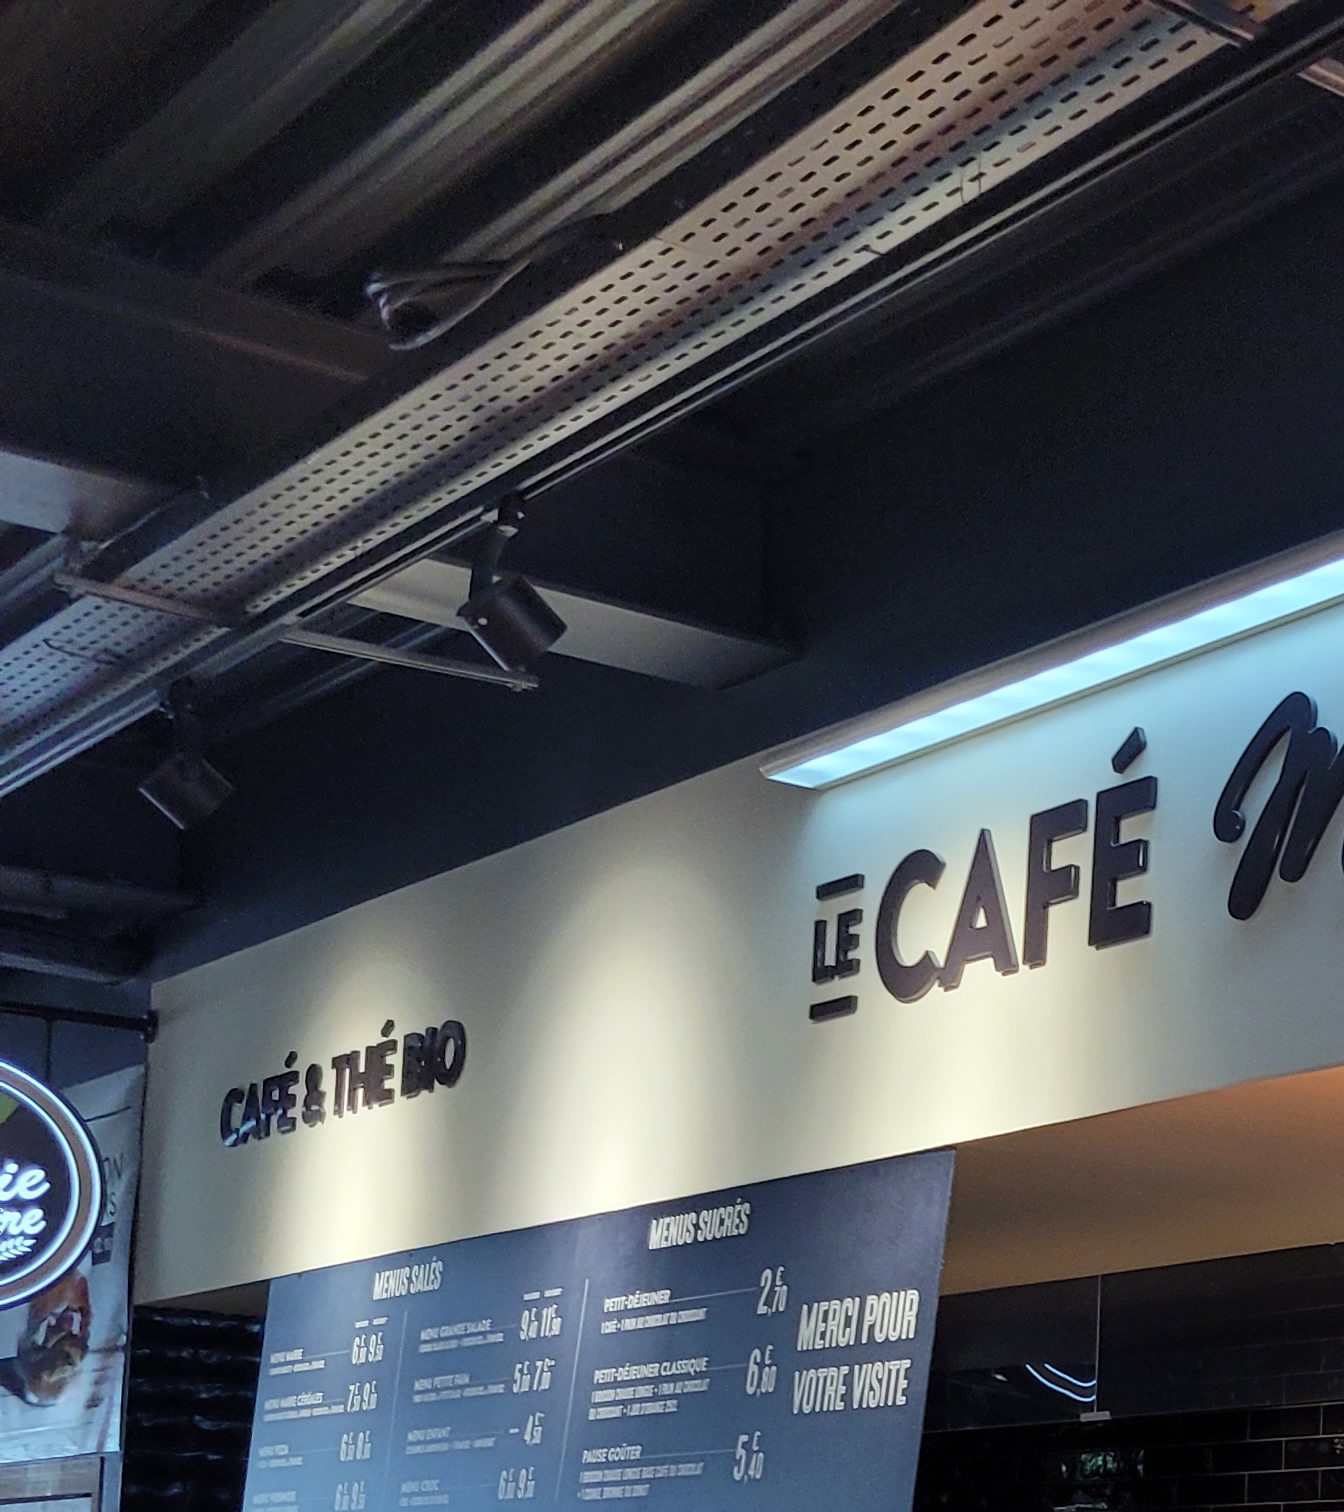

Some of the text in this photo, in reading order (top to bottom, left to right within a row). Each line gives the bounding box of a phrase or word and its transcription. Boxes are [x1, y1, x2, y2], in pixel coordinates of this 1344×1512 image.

[812, 908, 862, 983] LE
[876, 727, 1157, 1004] CAFÉ
[220, 1019, 467, 1147] CAFÉ & THÉ BIO
[648, 1197, 750, 1250] MENUS SUCRÉS
[373, 1256, 443, 1300] MENUS SALÉS
[604, 1289, 671, 1312] PETIT-DÉJEUNER
[797, 1289, 920, 1351] MERCI POUR
[594, 1362, 659, 1384] PETIT-DÉJEUNER
[660, 1357, 709, 1378] CLASSIQUE
[793, 1359, 912, 1415] VOTRE VISITE
[582, 1446, 607, 1464] PAUSE
